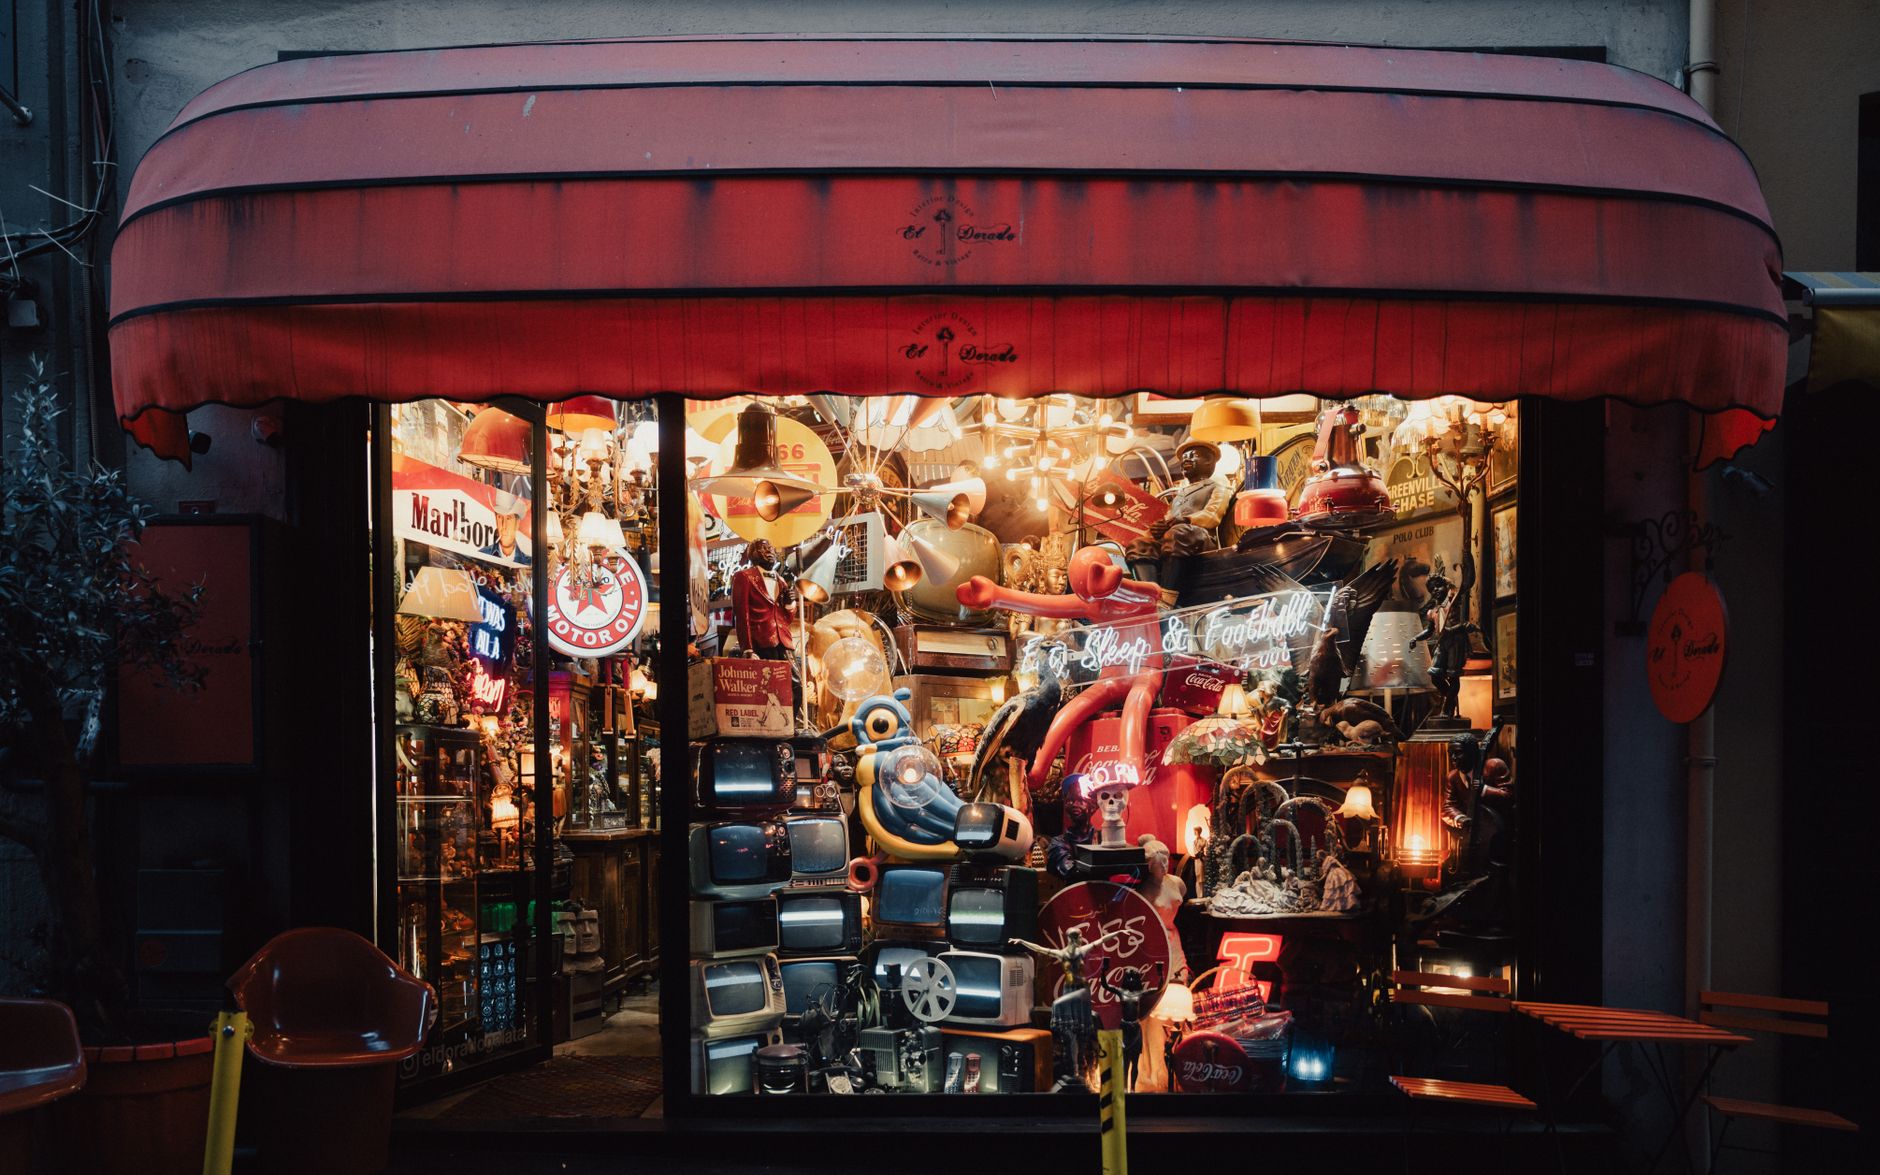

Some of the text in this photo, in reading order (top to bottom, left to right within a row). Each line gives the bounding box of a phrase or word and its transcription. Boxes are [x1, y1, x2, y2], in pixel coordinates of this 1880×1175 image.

[897, 222, 1016, 245] El Dorado
[899, 342, 1018, 367] El Dorado
[1388, 475, 1444, 500] GREENVILL
[1393, 526, 1434, 544] POLO CLUB
[548, 600, 638, 645] MOTOR OIL
[1081, 626, 1150, 675] Sleep
[1162, 616, 1188, 652] &
[718, 664, 758, 679] Johnnie
[719, 678, 758, 694] Walker
[725, 708, 759, 717] RED LABEL
[1096, 745, 1120, 753] BEB
